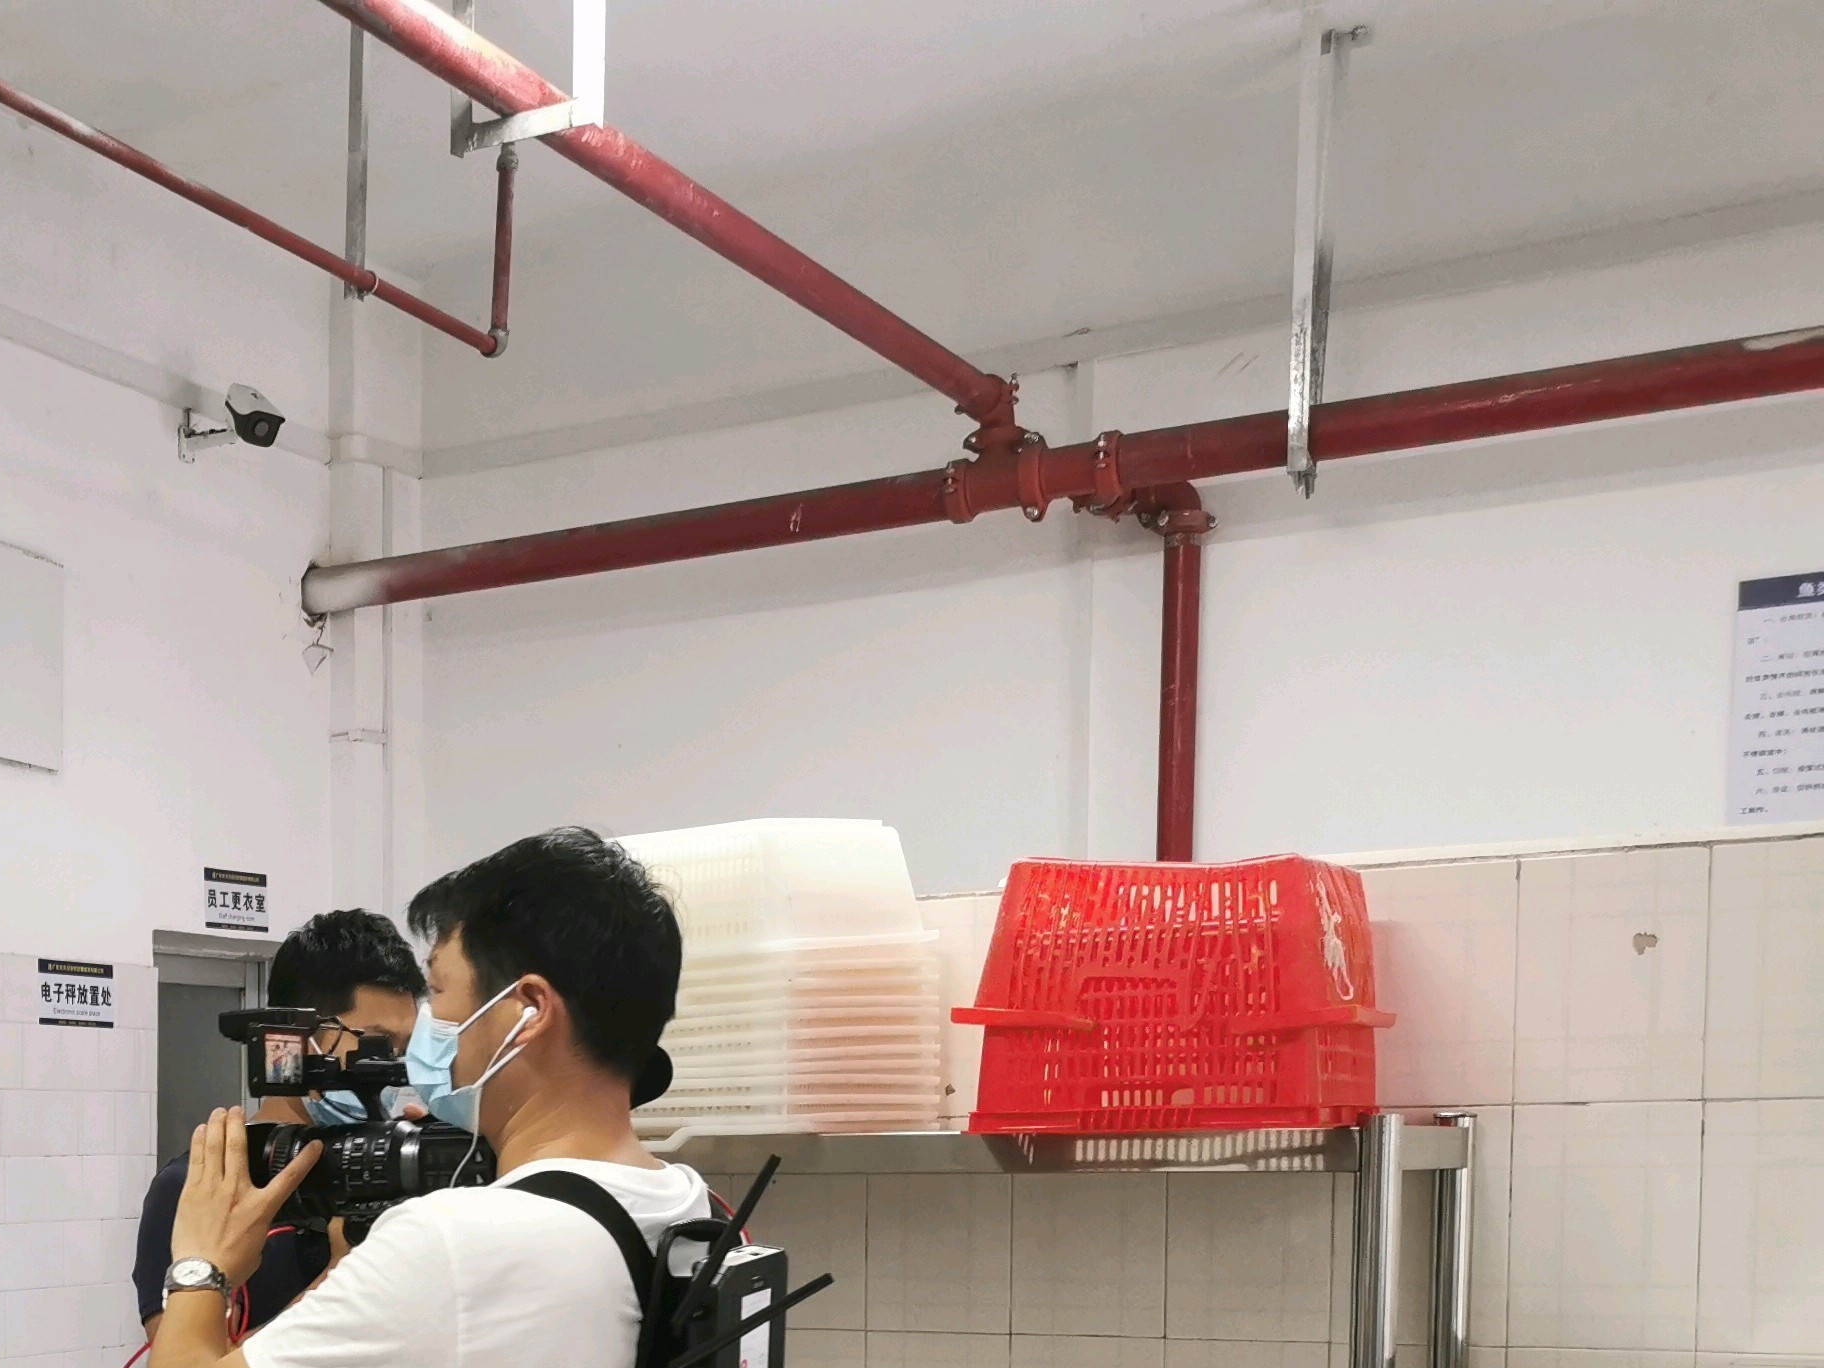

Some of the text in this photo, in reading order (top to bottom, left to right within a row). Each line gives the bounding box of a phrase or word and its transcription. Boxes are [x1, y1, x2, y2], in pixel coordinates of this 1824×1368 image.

[208, 889, 266, 913] 员工更衣室
[41, 981, 112, 1007] 电子秤放置处
